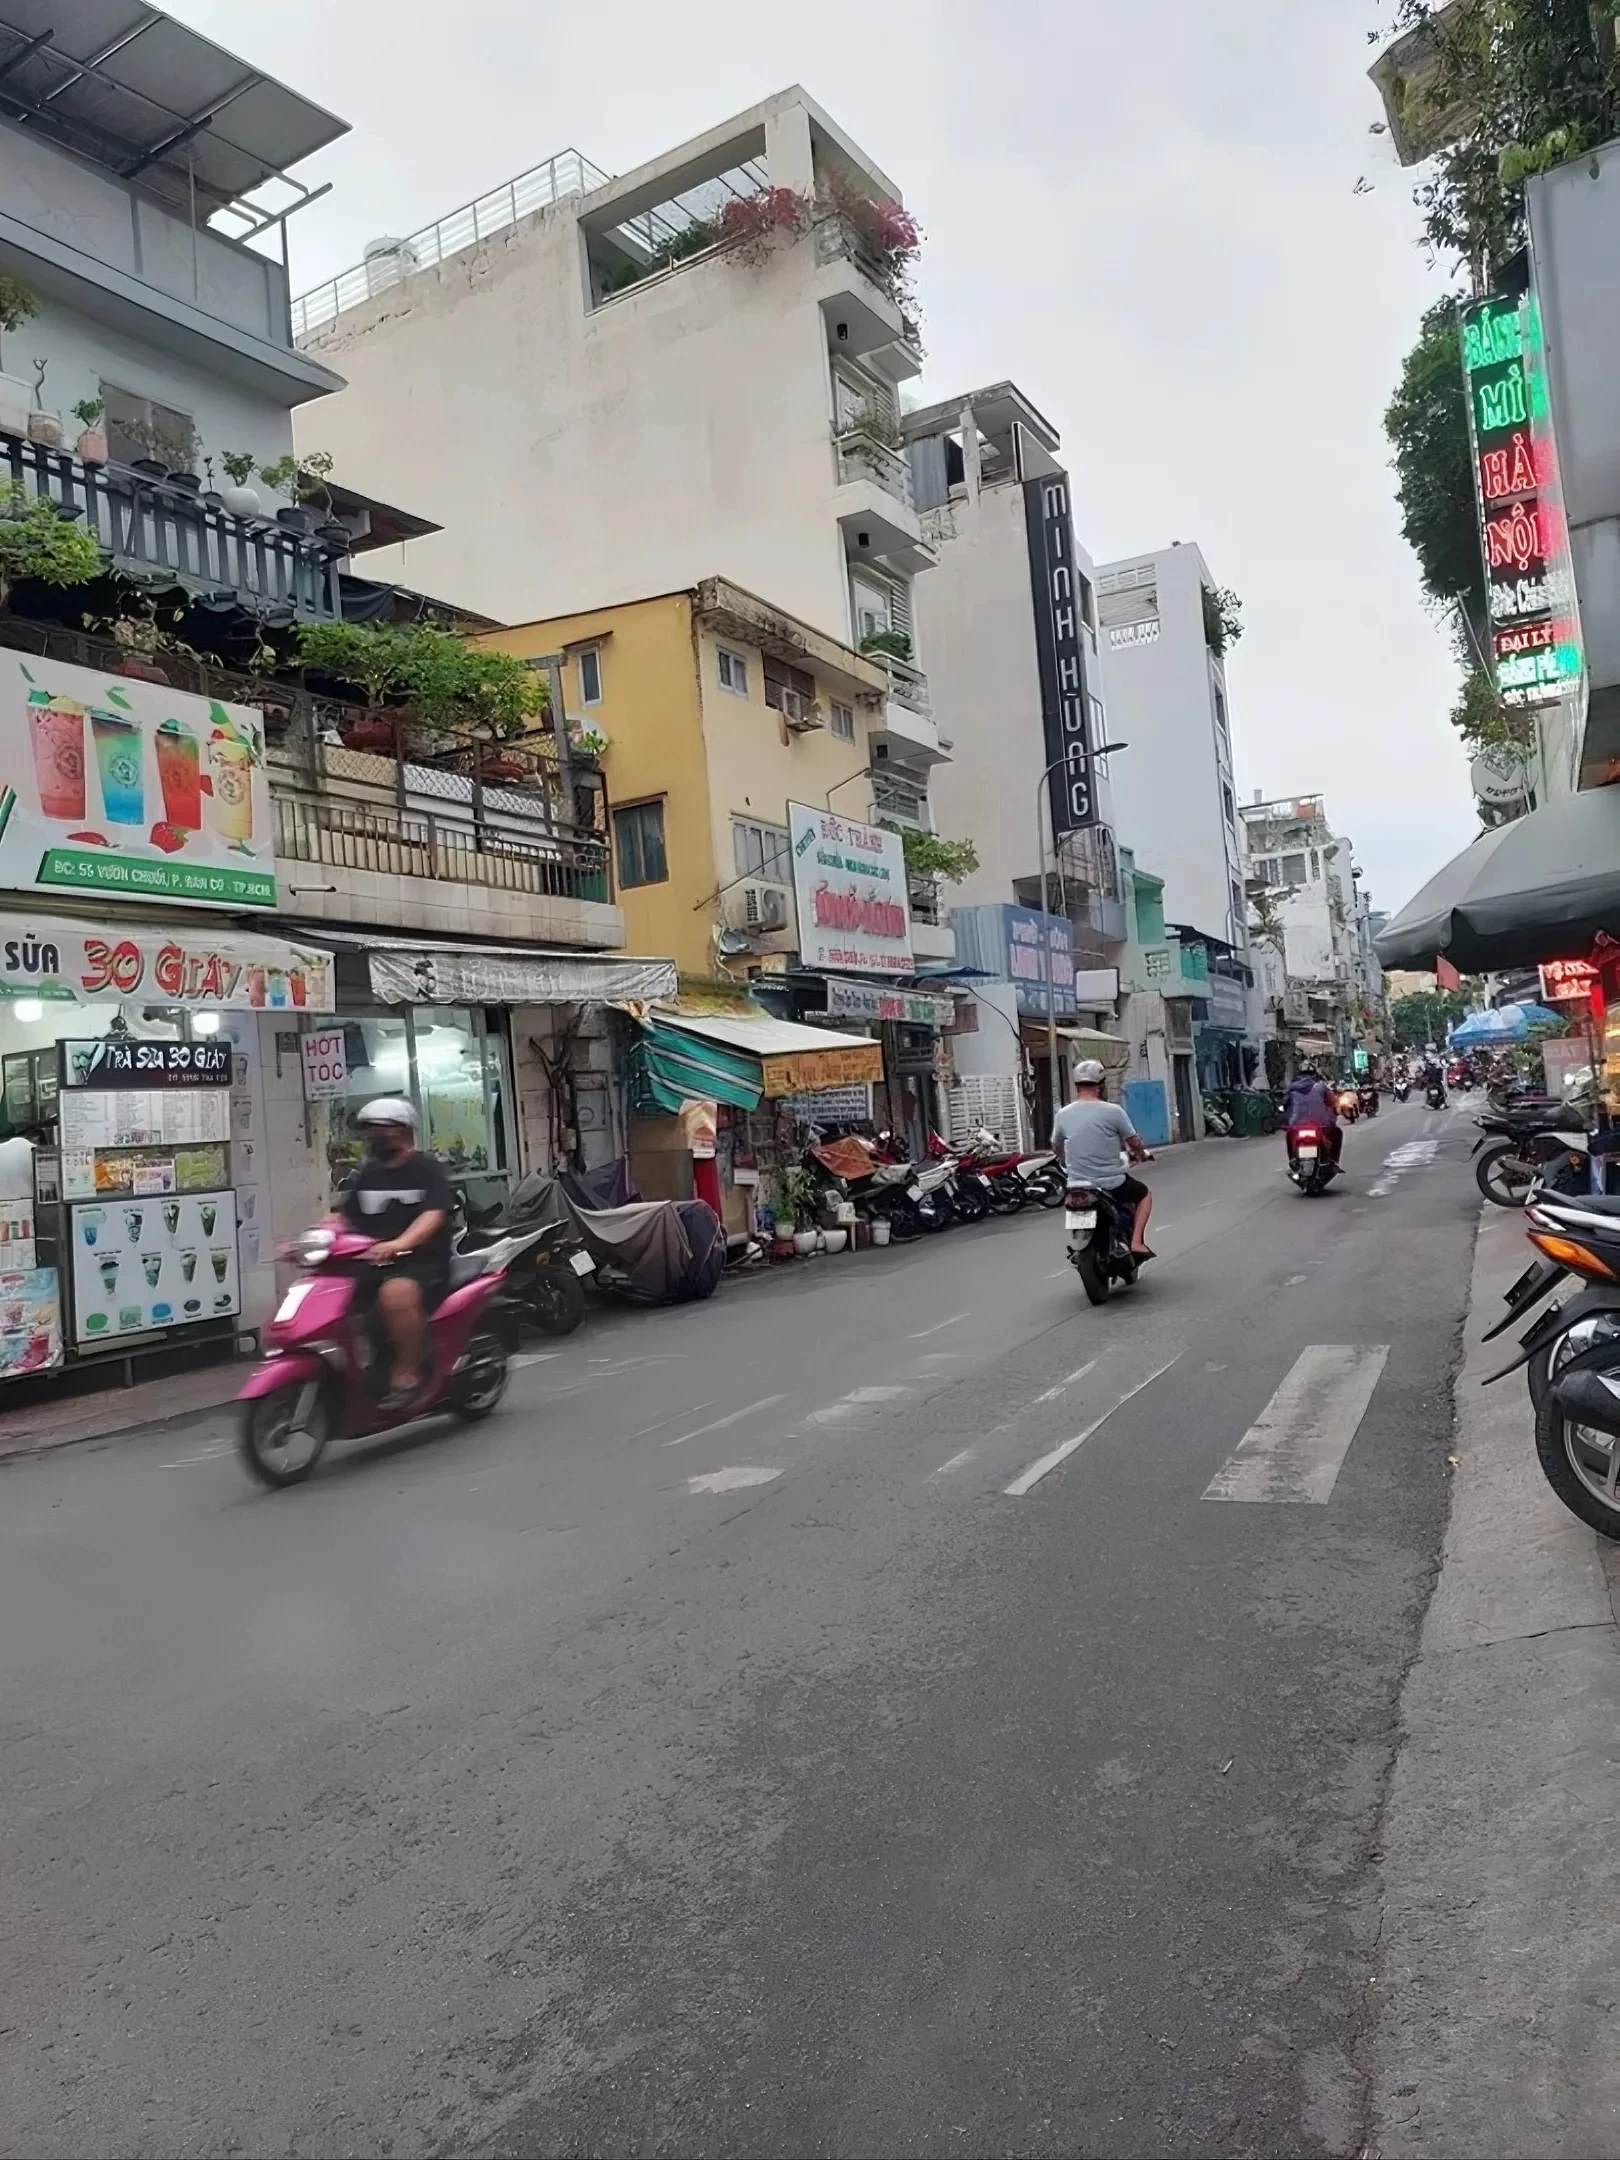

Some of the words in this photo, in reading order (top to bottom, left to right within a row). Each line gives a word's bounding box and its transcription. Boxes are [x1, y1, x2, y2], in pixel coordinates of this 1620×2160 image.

[1484, 433, 1536, 498] HÀ
[5, 933, 59, 973] SỮA
[81, 939, 145, 993] 30
[168, 1046, 191, 1068] 30
